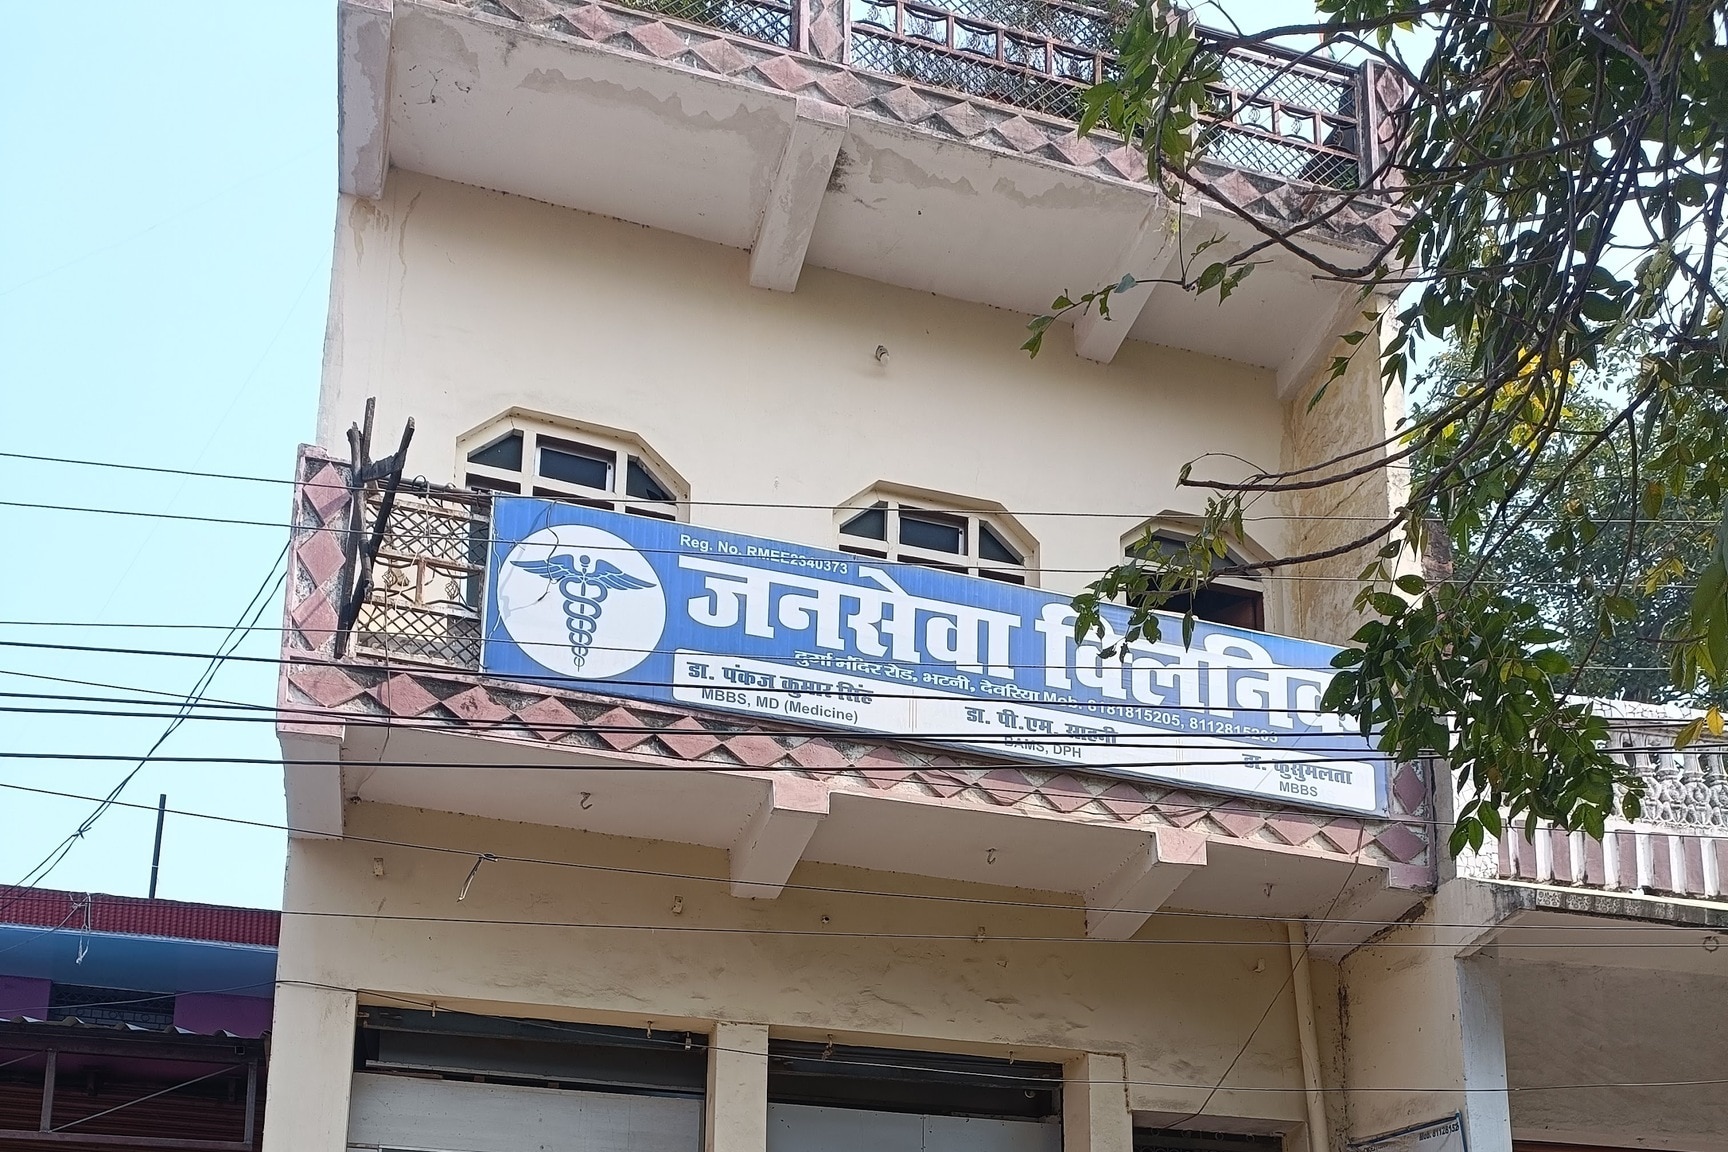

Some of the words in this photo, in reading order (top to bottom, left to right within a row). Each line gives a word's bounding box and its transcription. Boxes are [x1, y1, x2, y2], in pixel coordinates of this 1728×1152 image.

[680, 533, 713, 552] Reg.
[717, 540, 742, 556] No.
[678, 553, 1022, 680] जनसेवा
[722, 664, 777, 690] पंकज
[780, 673, 833, 700] कुमार
[794, 650, 833, 667] दुर्गा
[883, 663, 918, 683] रोड,
[922, 671, 976, 693] भटनी,
[980, 679, 1041, 702] देवरिया
[1043, 691, 1083, 710] Mob.
[1087, 699, 1185, 730] 8181815205,
[701, 687, 751, 708] MBBS,
[756, 694, 780, 711] MD
[784, 700, 859, 725] (Medicine)
[1004, 737, 1049, 755] BAMS,
[1053, 743, 1082, 759] DPH
[1279, 780, 1318, 797] MBBS
